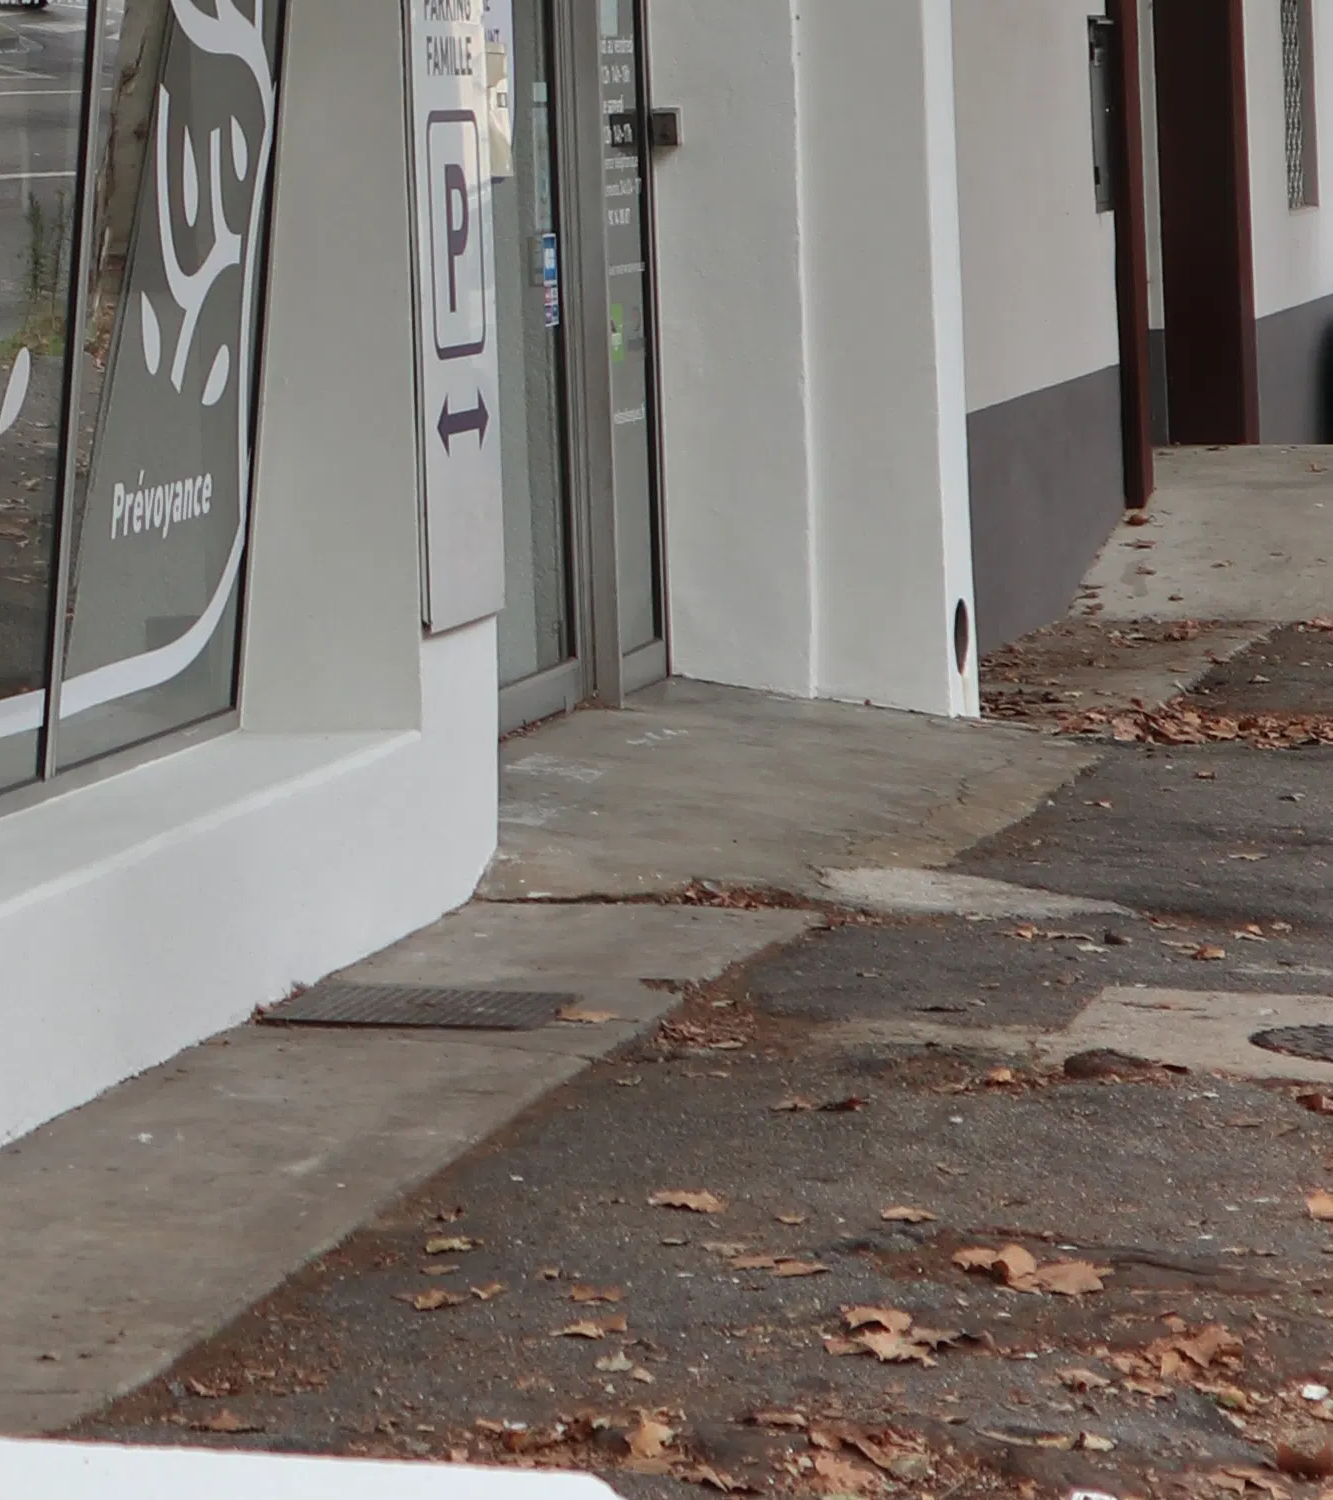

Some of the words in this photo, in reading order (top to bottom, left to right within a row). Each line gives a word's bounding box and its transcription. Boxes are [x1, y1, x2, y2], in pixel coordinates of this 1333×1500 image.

[426, 35, 472, 76] FAMILLE
[444, 162, 468, 314] P
[111, 469, 212, 540] Prévoyance
